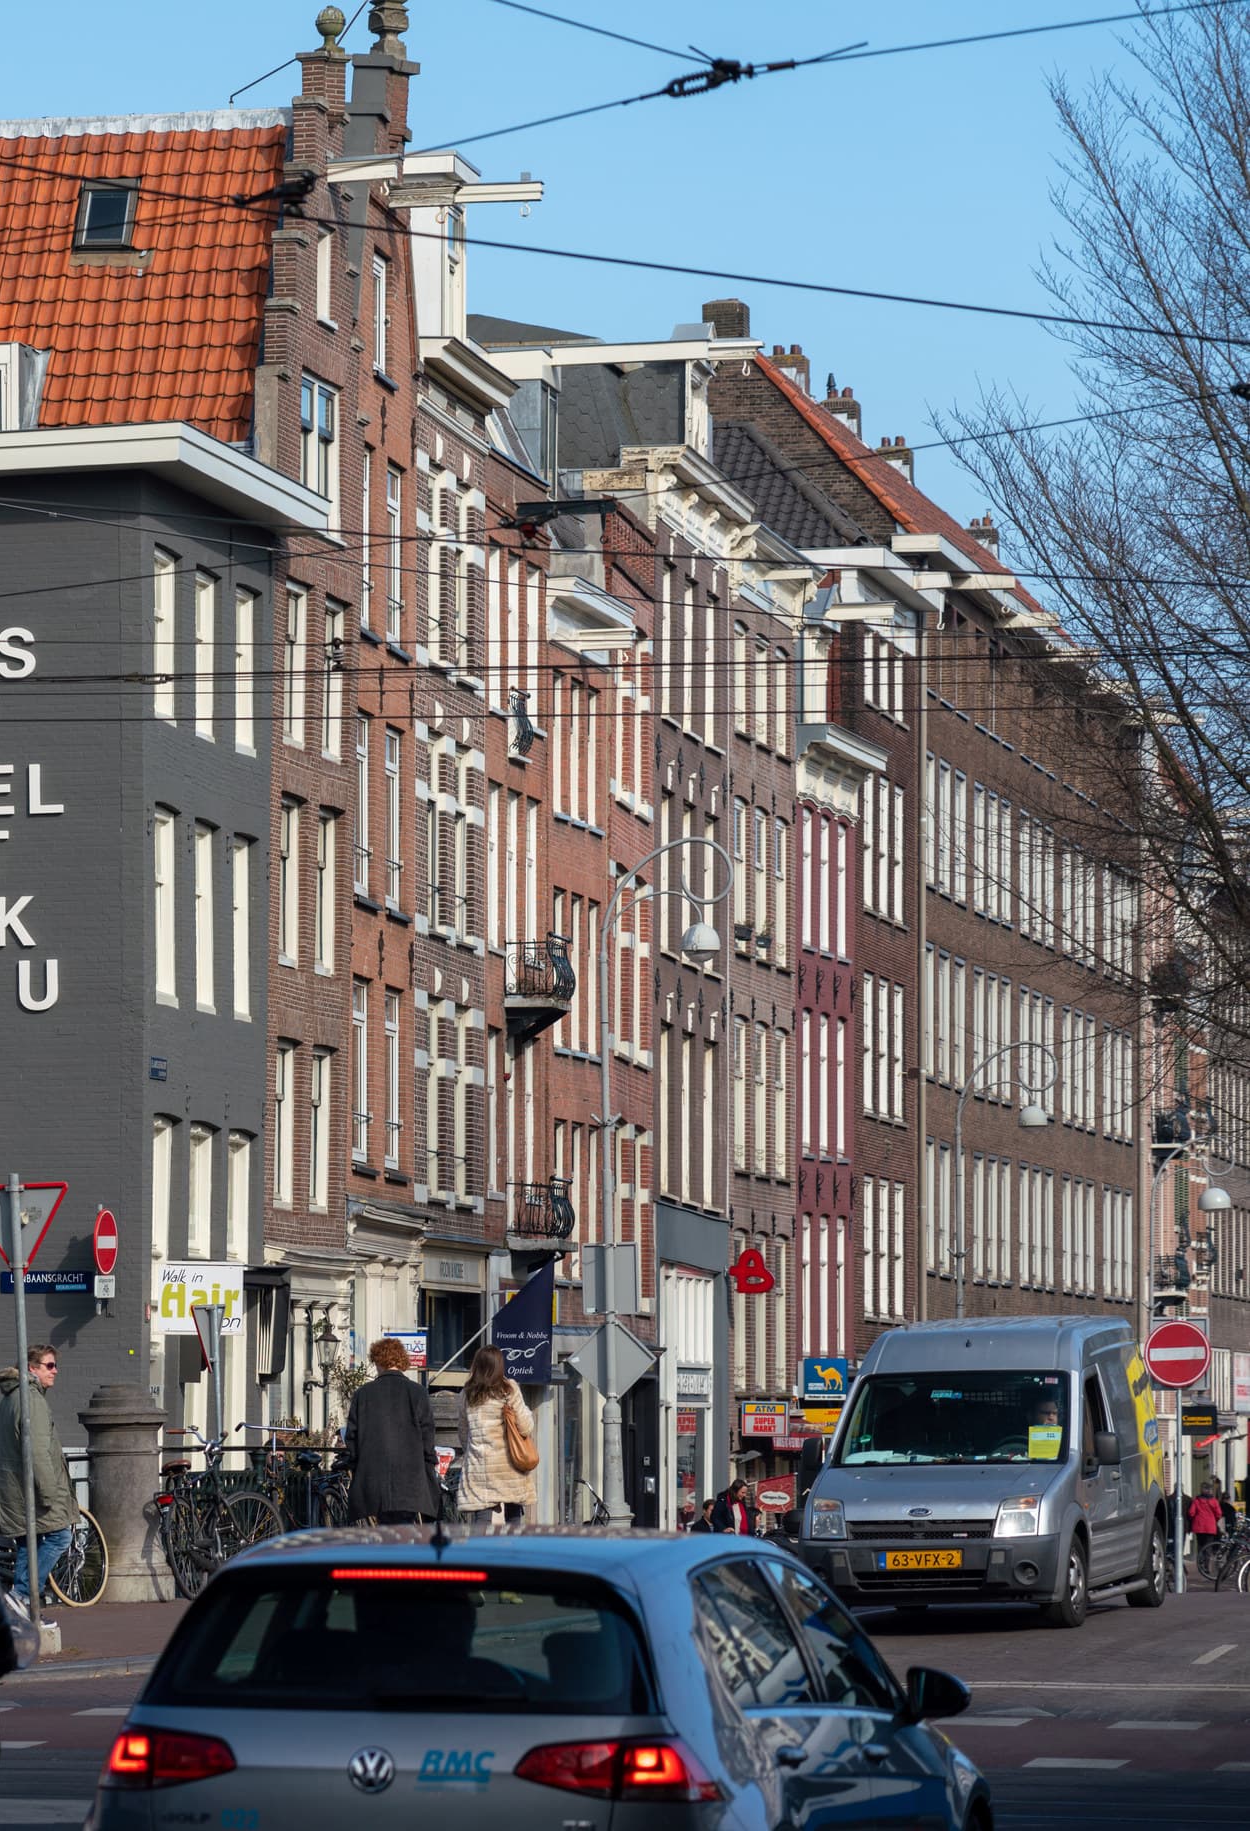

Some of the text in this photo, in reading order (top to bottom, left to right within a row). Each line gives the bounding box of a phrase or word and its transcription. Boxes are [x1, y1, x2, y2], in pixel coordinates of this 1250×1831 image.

[17, 958, 59, 1012] U
[162, 1269, 203, 1284] Walk in
[507, 1366, 534, 1375] Optiek
[754, 1405, 776, 1413] ATM
[892, 1553, 955, 1567] 63-VFX-2
